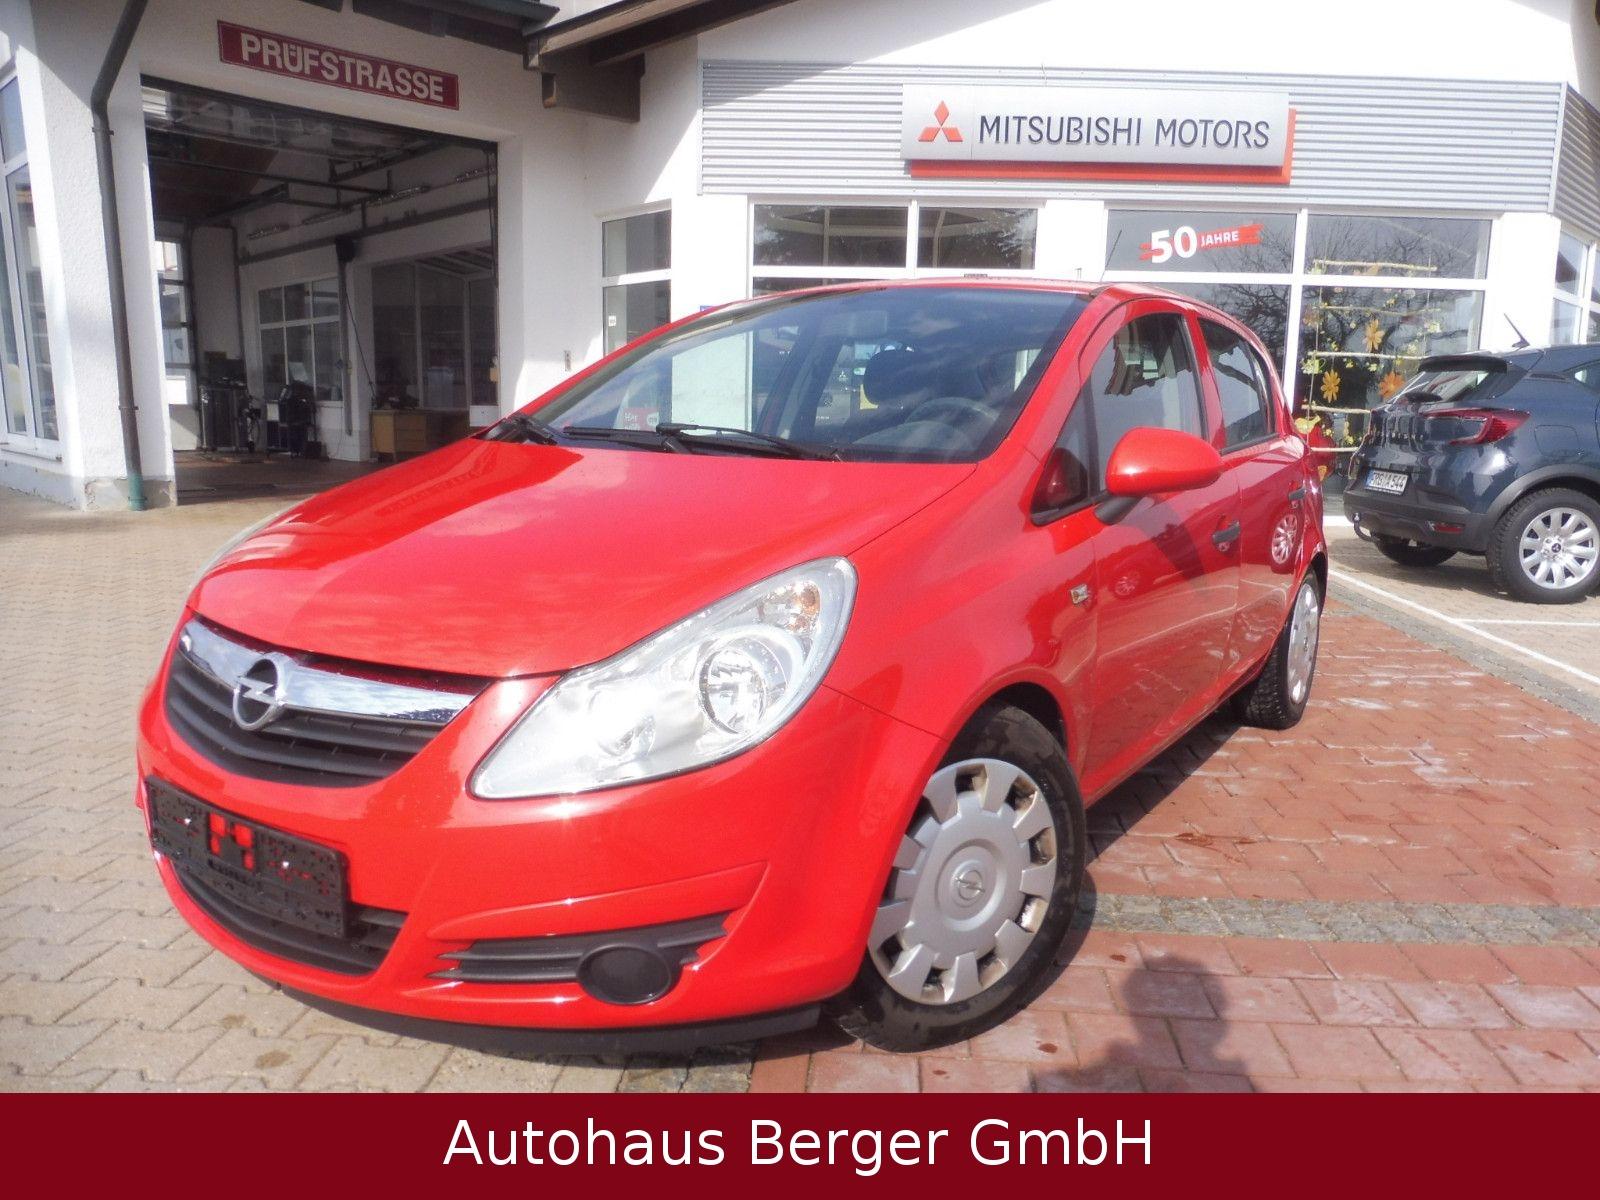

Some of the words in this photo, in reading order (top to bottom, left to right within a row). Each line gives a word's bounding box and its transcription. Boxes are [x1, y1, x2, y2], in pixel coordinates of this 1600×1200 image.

[240, 32, 444, 102] PRÜFSTRASSE
[979, 115, 1142, 146] MITSUBISHI
[1154, 118, 1271, 149] MOTORS
[1151, 226, 1198, 264] 50
[1201, 230, 1240, 248] JAHRE
